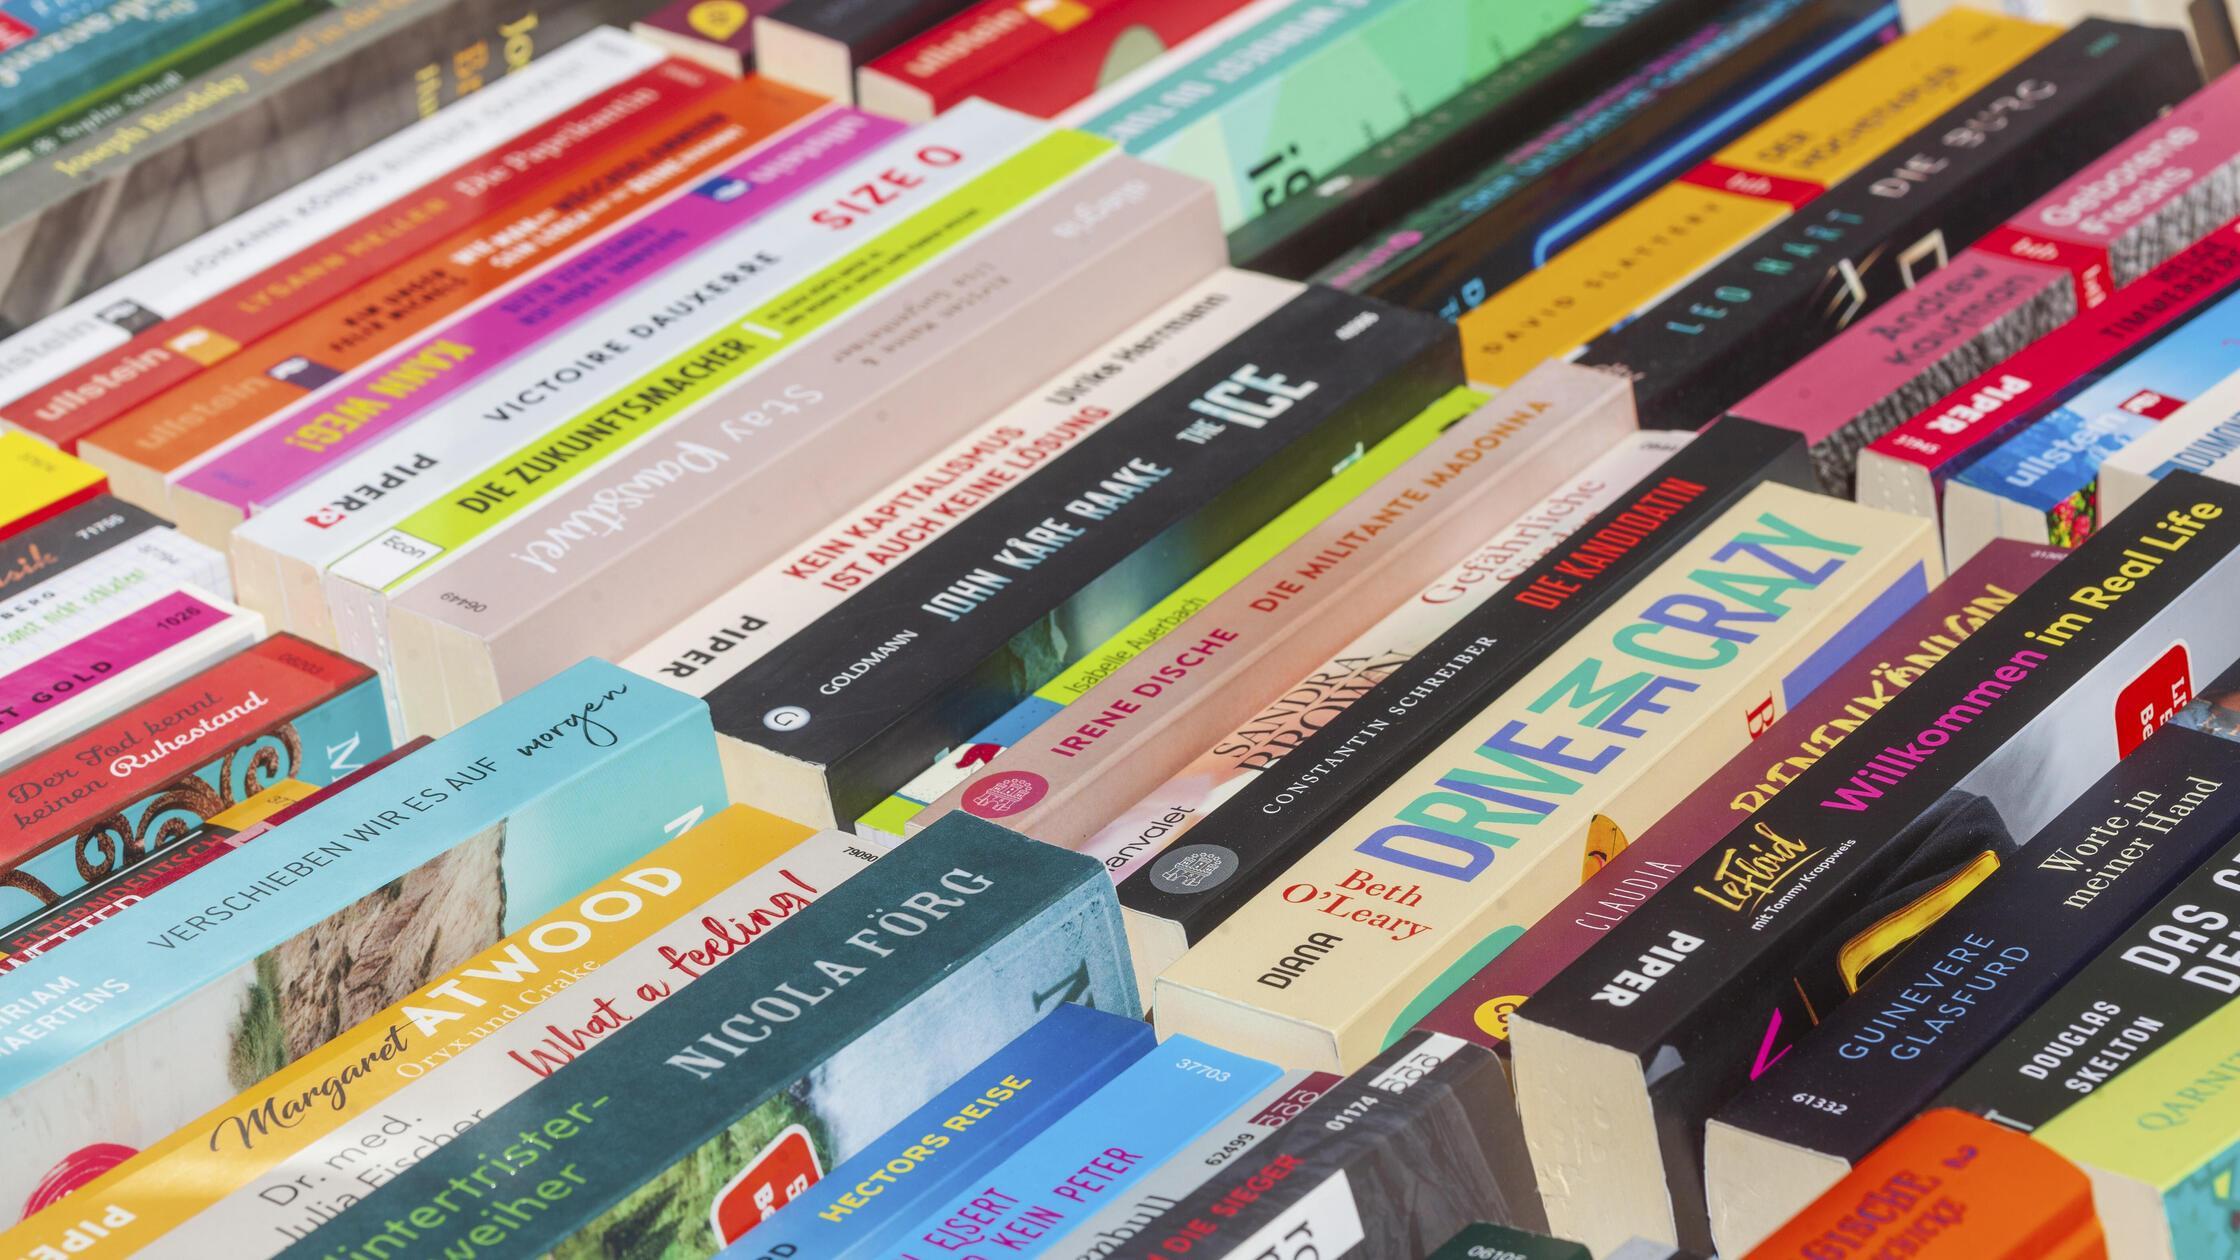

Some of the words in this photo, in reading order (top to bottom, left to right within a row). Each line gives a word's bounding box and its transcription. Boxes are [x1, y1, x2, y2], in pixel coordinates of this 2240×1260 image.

[810, 167, 926, 231] SIZE
[2040, 126, 2199, 227] Geborene
[1665, 284, 1753, 336] LEO
[35, 346, 172, 422] ullstein
[336, 452, 440, 514] PIPER
[483, 340, 629, 424] VICTOIRE
[629, 251, 783, 341] DAUXERRE
[456, 480, 518, 515] DIE
[504, 338, 758, 486] ZUKUNFTSMACHER
[719, 383, 825, 443] Stay
[1175, 417, 1228, 446] THE
[1187, 362, 1320, 430] ICE
[1925, 374, 2034, 435] PIPER
[821, 561, 875, 594] IST
[867, 513, 947, 569] AUCH
[932, 466, 1019, 520] KEINE
[1011, 404, 1112, 473] LÖSUNG
[1064, 456, 1174, 522] RAAKE
[2005, 410, 2130, 489] ullstein
[382, 533, 427, 561] Econ
[782, 537, 855, 582] KEIN
[848, 424, 1027, 541] KAPITALISMUS
[993, 516, 1088, 572] KÅRE
[920, 567, 1014, 623] JOHN
[1049, 697, 1142, 759] IRENE
[1130, 626, 1240, 700] DISCHE
[1248, 578, 1305, 615] DIE
[1295, 488, 1430, 583] MILITANTE
[1422, 400, 1553, 490] MADONNA
[1212, 654, 1376, 760] SANDRA
[1420, 479, 1607, 606] Gefährliche
[1611, 511, 1866, 671] CRAZY
[31, 659, 114, 706] GOLD
[659, 612, 770, 681] PIPER
[819, 628, 919, 697] GOLDMANN
[1062, 642, 1137, 697] Isabelle
[1129, 594, 1207, 653] Auerbach
[1261, 718, 1391, 816] CONSTANTIN
[1387, 634, 1500, 717] SCHREIBER
[1513, 574, 1583, 613] DIE
[1553, 476, 1711, 581] KANDIDATIN
[1524, 656, 1702, 741] ME
[6, 768, 81, 808] Der
[74, 733, 146, 768] Tod
[147, 690, 225, 739] kennt
[13, 777, 109, 831] keinen
[109, 690, 269, 779] Ruhestand
[1589, 929, 1707, 1009] PIPER
[1819, 649, 2050, 813] Willkommen
[2023, 611, 2095, 648] im
[2068, 548, 2165, 611] Real
[2139, 501, 2225, 553] Life
[146, 840, 353, 951] VERSCHIEBEN
[343, 808, 412, 843] WIR
[401, 787, 450, 814] ES
[444, 755, 498, 793] AUF
[515, 683, 629, 758] morgen
[1352, 718, 1629, 884] DRIVE
[2037, 816, 2132, 876] Worte
[2112, 788, 2163, 816] in
[2061, 837, 2155, 911] meiner
[2134, 775, 2224, 836] Hand
[1334, 868, 1426, 909] Beth
[1574, 859, 1684, 932] CLAUDIA
[1750, 915, 1774, 934] mit
[1762, 882, 1807, 923] Tommy
[1800, 836, 1858, 887] Krappweis
[209, 1016, 421, 1153] Margaret
[399, 866, 684, 1038] ATWOOD
[1256, 930, 1345, 991] DIANA
[1837, 931, 1997, 1061] GUINEVERE
[1889, 945, 2032, 1062] GLASFURD
[2018, 1000, 2124, 1082] DOUGLAS
[2118, 903, 2230, 976] DAS
[257, 1174, 328, 1208] Dr.
[324, 1113, 424, 1172] med.
[506, 995, 634, 1080] What
[635, 977, 673, 1004] a
[842, 846, 878, 863] 79090
[323, 1095, 610, 1260] intertrister-
[662, 957, 868, 1081] NICOLA
[844, 866, 996, 960] FÖRG
[395, 1036, 472, 1081] Oryx
[467, 1003, 523, 1039] und
[517, 957, 602, 1007] Crake
[2064, 1015, 2166, 1095] SKELTON
[1174, 1057, 1233, 1084] 37703
[1791, 1093, 1850, 1117] 61332
[817, 1132, 951, 1224] HECTORS
[942, 1073, 1034, 1133] REISE
[1161, 1216, 1220, 1254] DIE
[1209, 1153, 1307, 1219] SIEGER
[1324, 1094, 1380, 1133] 01174
[1203, 1132, 1257, 1168] 62499
[922, 1185, 1022, 1252] EISERT
[988, 1204, 1066, 1253] KEIN
[1052, 1145, 1145, 1204] PETER
